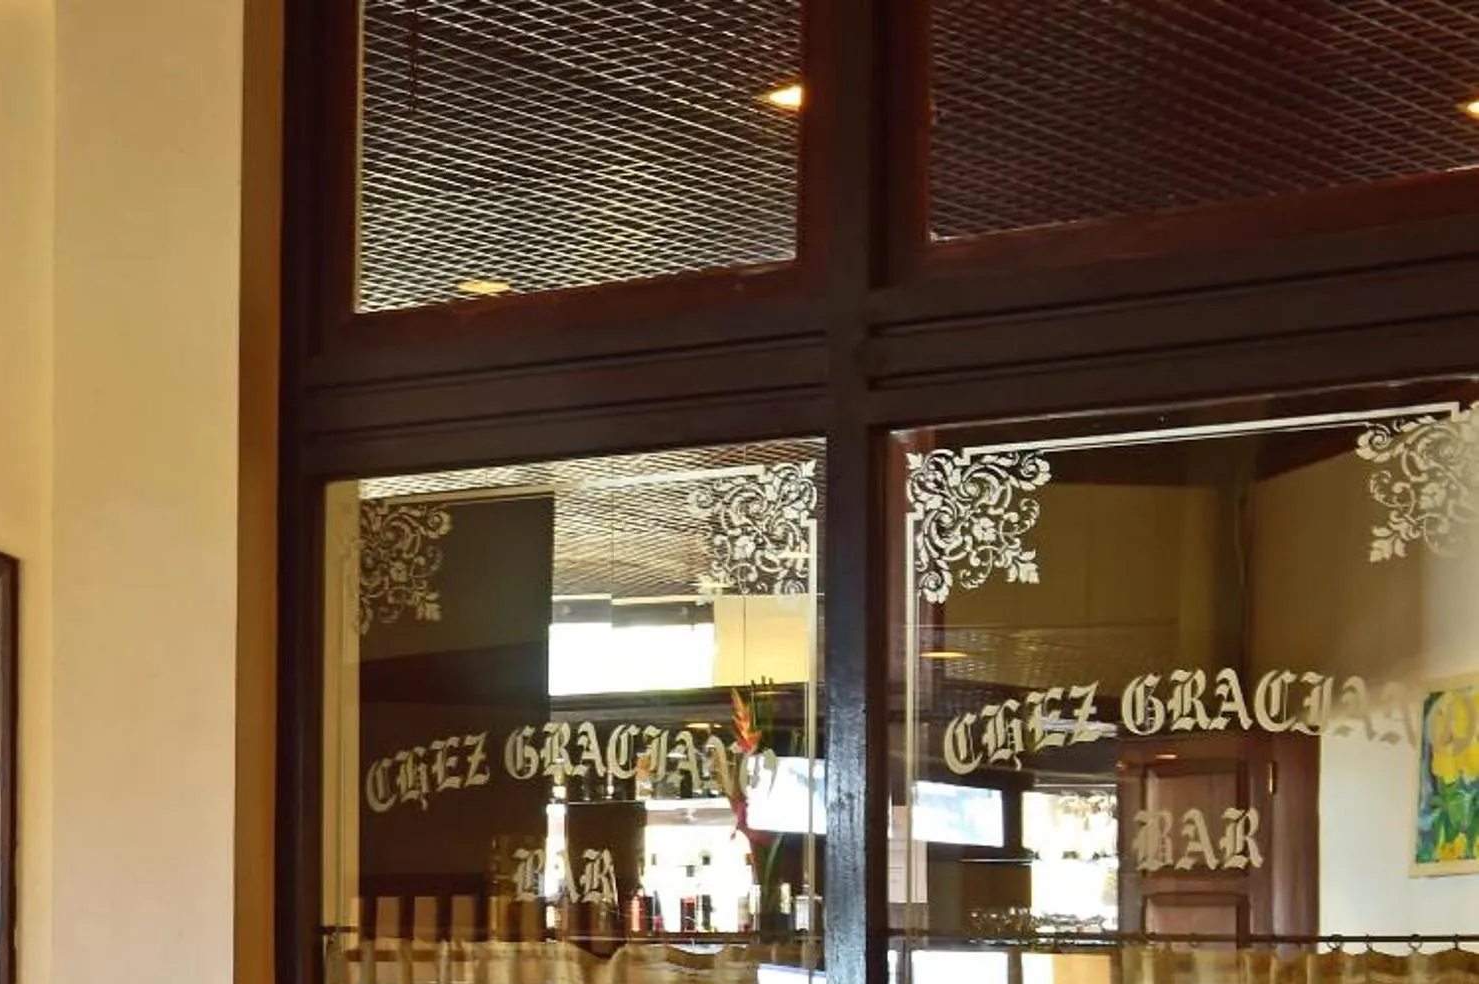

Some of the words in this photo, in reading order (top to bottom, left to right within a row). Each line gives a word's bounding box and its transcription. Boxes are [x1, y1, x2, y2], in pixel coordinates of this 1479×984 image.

[943, 679, 1102, 776] CHEZ
[364, 729, 491, 814] CHEZ
[510, 847, 620, 908] BAR
[1132, 806, 1265, 873] BAR
